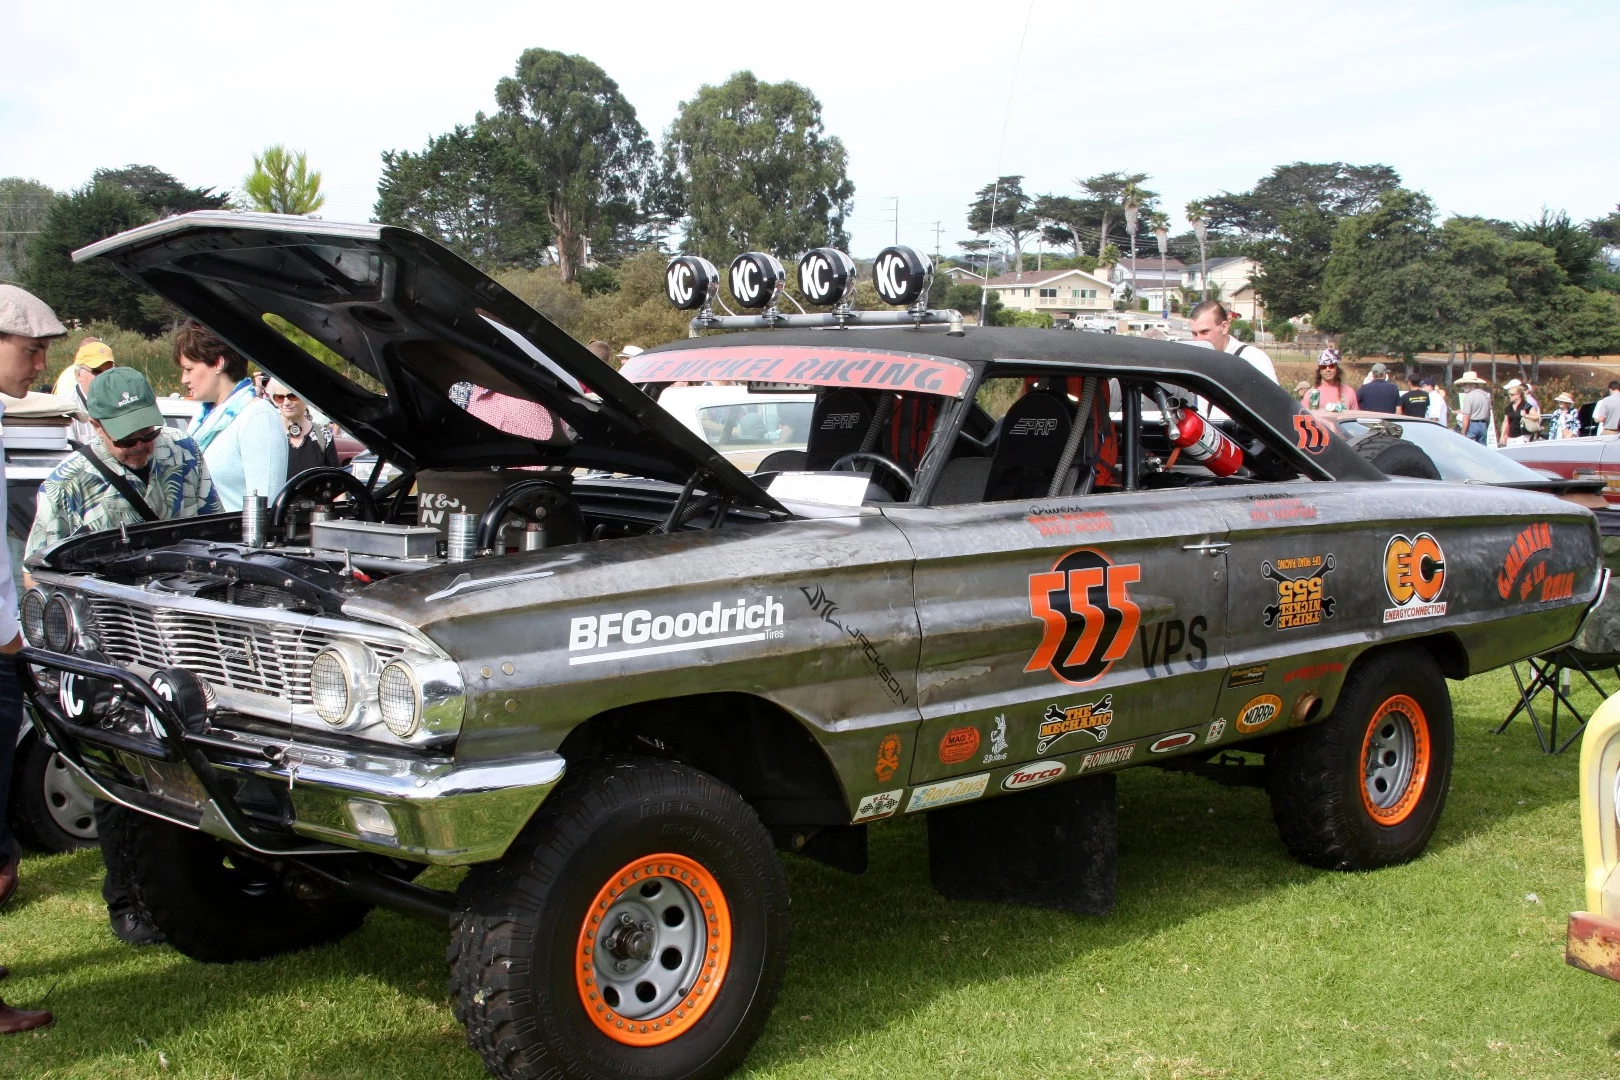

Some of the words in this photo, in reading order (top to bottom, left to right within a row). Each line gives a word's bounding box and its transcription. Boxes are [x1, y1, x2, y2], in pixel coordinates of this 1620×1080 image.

[667, 263, 693, 308] KC
[732, 260, 759, 301] KC
[801, 250, 829, 299] KC
[876, 254, 904, 299] KC
[666, 358, 784, 378] NICKEL
[784, 358, 946, 391] RACING
[118, 395, 139, 407] ROLEX
[1010, 418, 1057, 436] PRP
[1293, 414, 1329, 450] 555
[421, 509, 444, 524] N
[1029, 504, 1083, 515] Drivers
[1279, 577, 1322, 604] 555
[1023, 563, 1140, 673] 555
[1279, 611, 1320, 628] TRIPLE
[1280, 599, 1321, 615] NICKEL
[1384, 604, 1446, 622] ENERGYCONNECTION
[569, 595, 784, 652] BFGoodrich
[765, 629, 784, 640] Tires
[1140, 615, 1208, 679] VPS
[846, 625, 909, 705] JACKSON
[1040, 711, 1112, 737] MECHANIC
[1065, 705, 1092, 721] THE
[948, 734, 966, 745] MAG
[1078, 746, 1134, 774] FLOWMASTER
[1010, 767, 1063, 785] Torco
[921, 786, 950, 803] Ron
[949, 778, 985, 797] Davis
